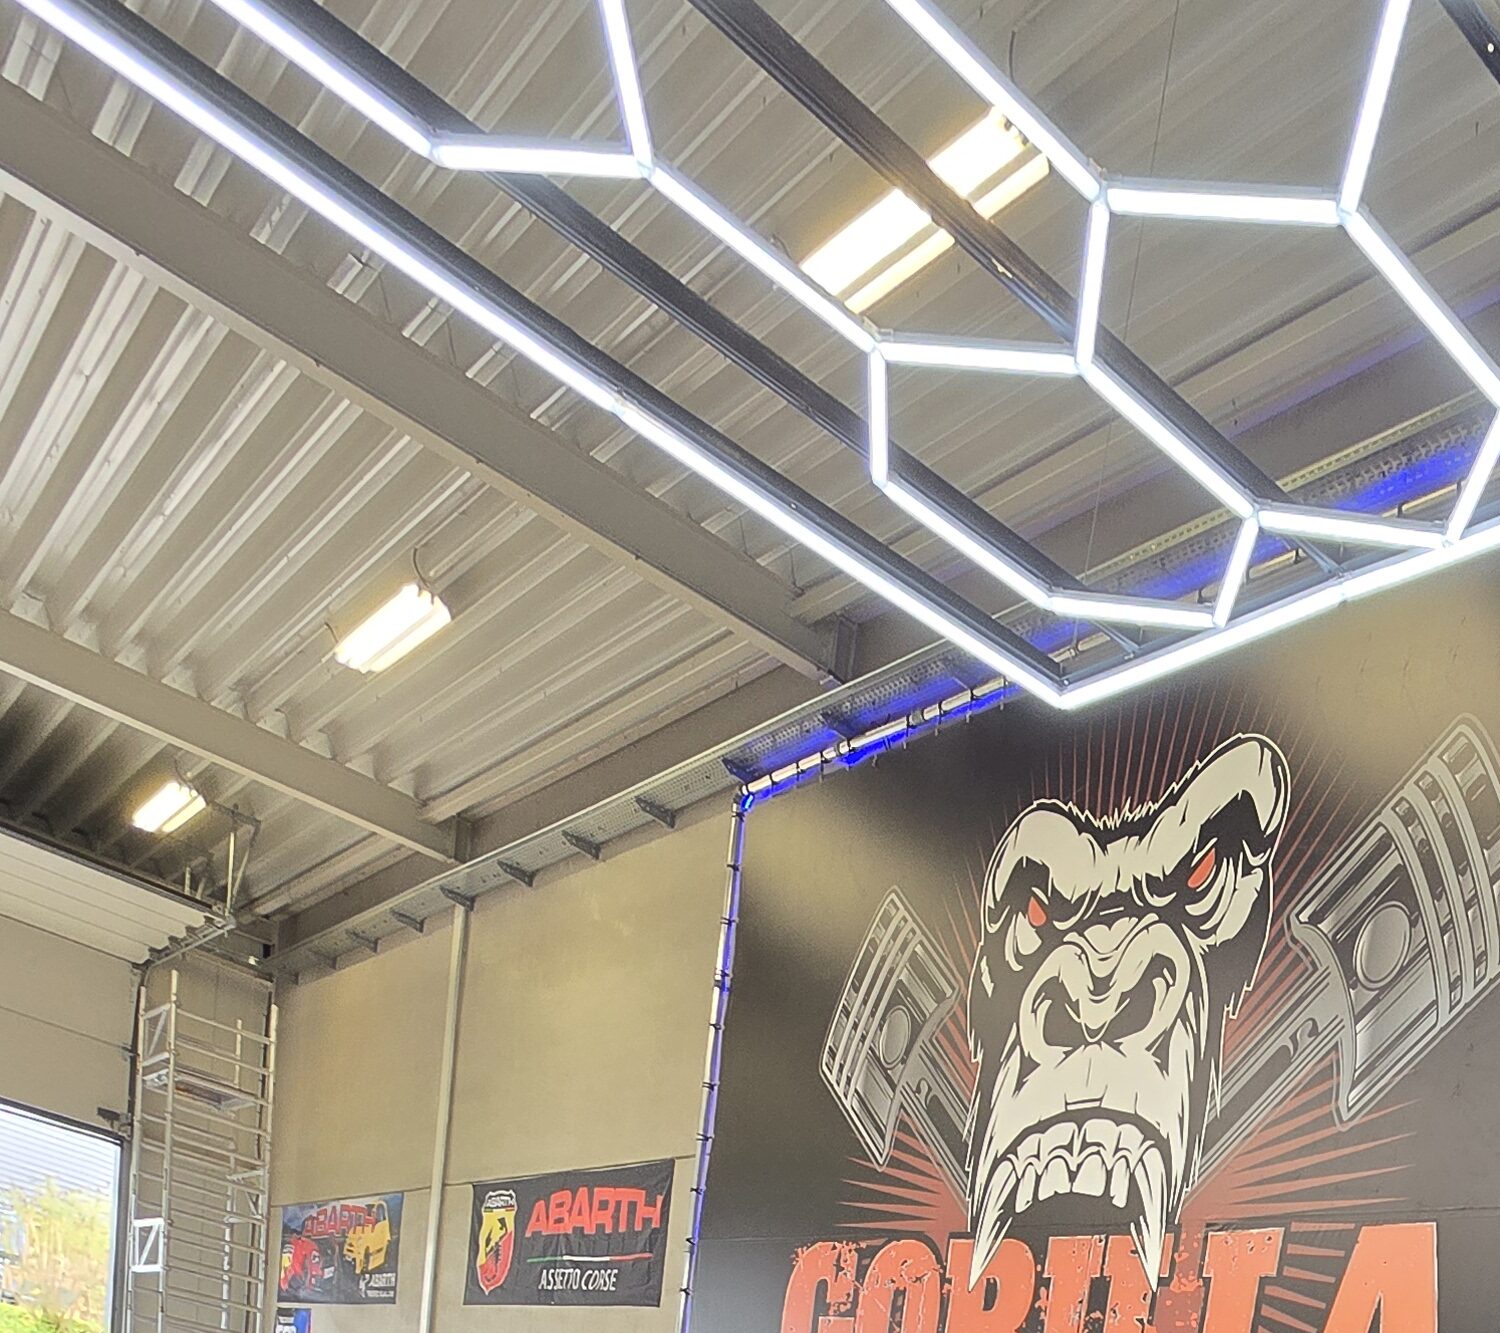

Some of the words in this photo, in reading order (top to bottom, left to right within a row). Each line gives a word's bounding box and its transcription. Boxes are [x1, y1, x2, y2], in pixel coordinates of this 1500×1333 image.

[525, 1186, 664, 1239] ABARTH
[538, 1268, 580, 1291] ASSETTO
[581, 1268, 618, 1291] CORSE
